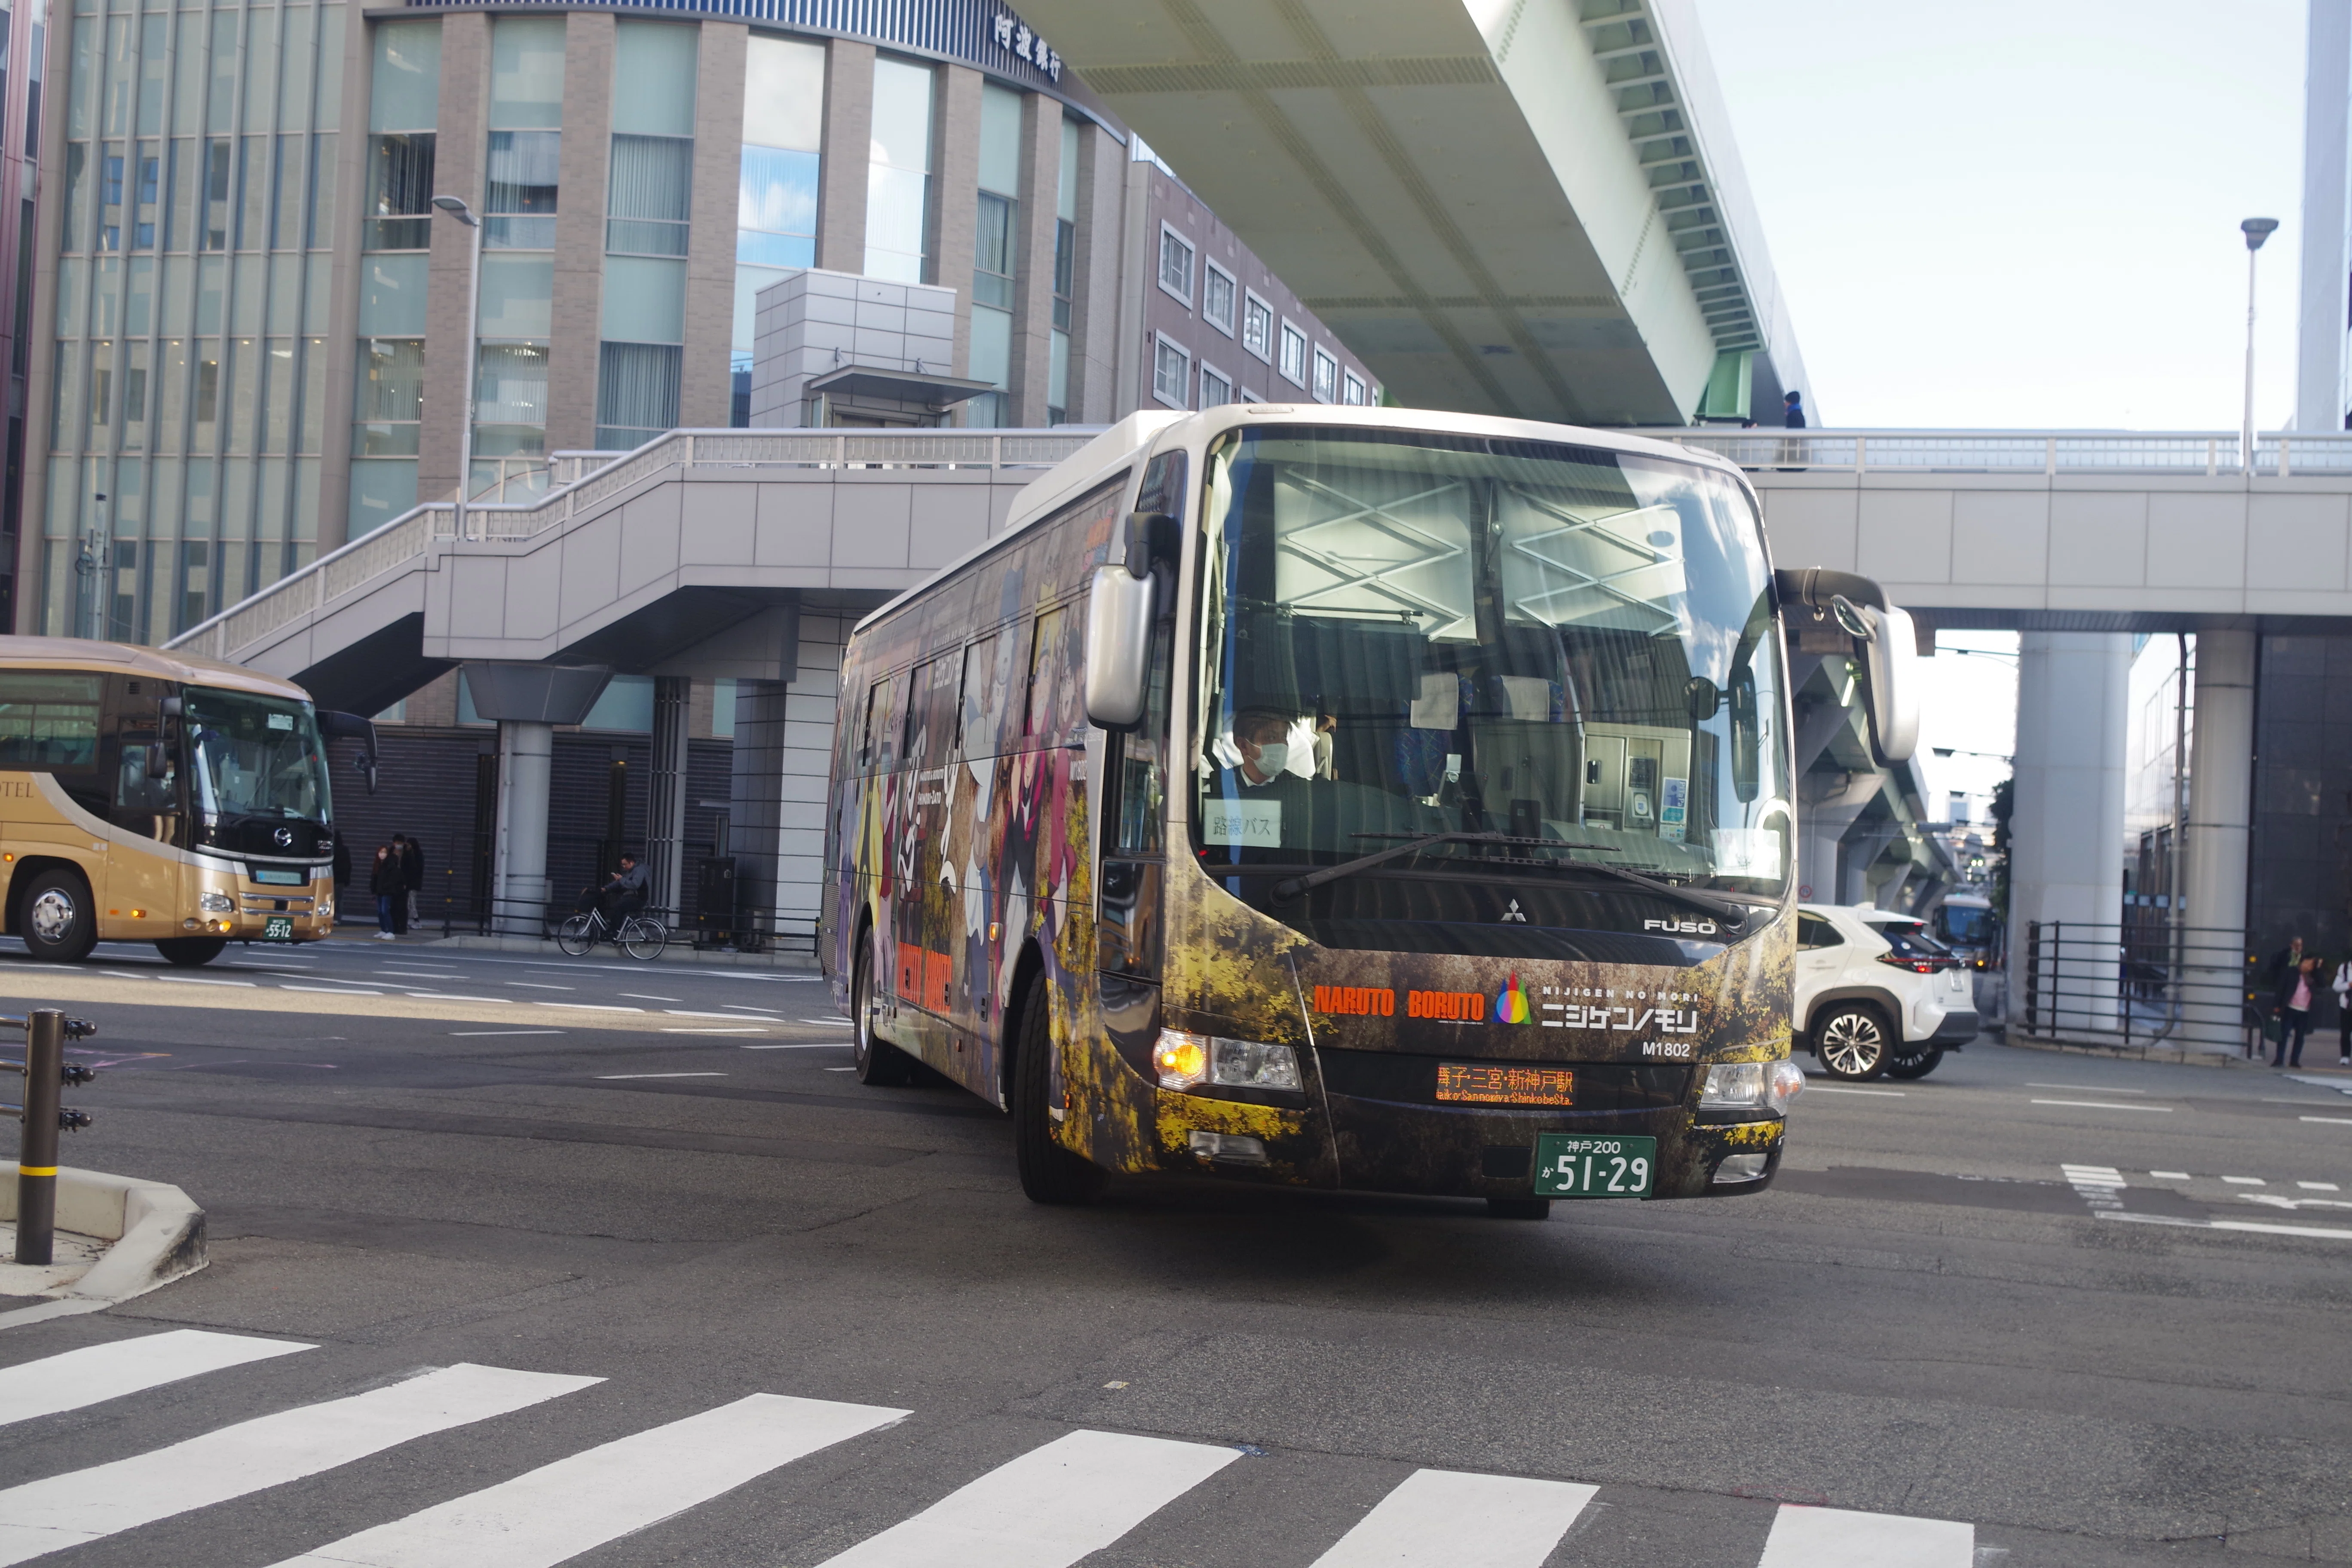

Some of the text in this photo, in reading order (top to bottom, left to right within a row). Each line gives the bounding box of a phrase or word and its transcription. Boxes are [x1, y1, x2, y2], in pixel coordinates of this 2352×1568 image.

[994, 14, 1061, 83] 阿波銀行
[0, 781, 34, 798] TEL
[1213, 816, 1271, 836] 路線バス
[268, 924, 291, 937] 55-12
[1644, 919, 1716, 934] FUSO
[1543, 986, 1698, 1002] NIJIGEN NO MORI
[1314, 985, 1485, 1021] NARUTO BORUTO
[1541, 1004, 1697, 1033] ニジゲンノモリ
[1642, 1041, 1690, 1057] M1802
[1567, 1140, 1621, 1154] 神戸200
[1541, 1155, 1648, 1192] か 51-29
